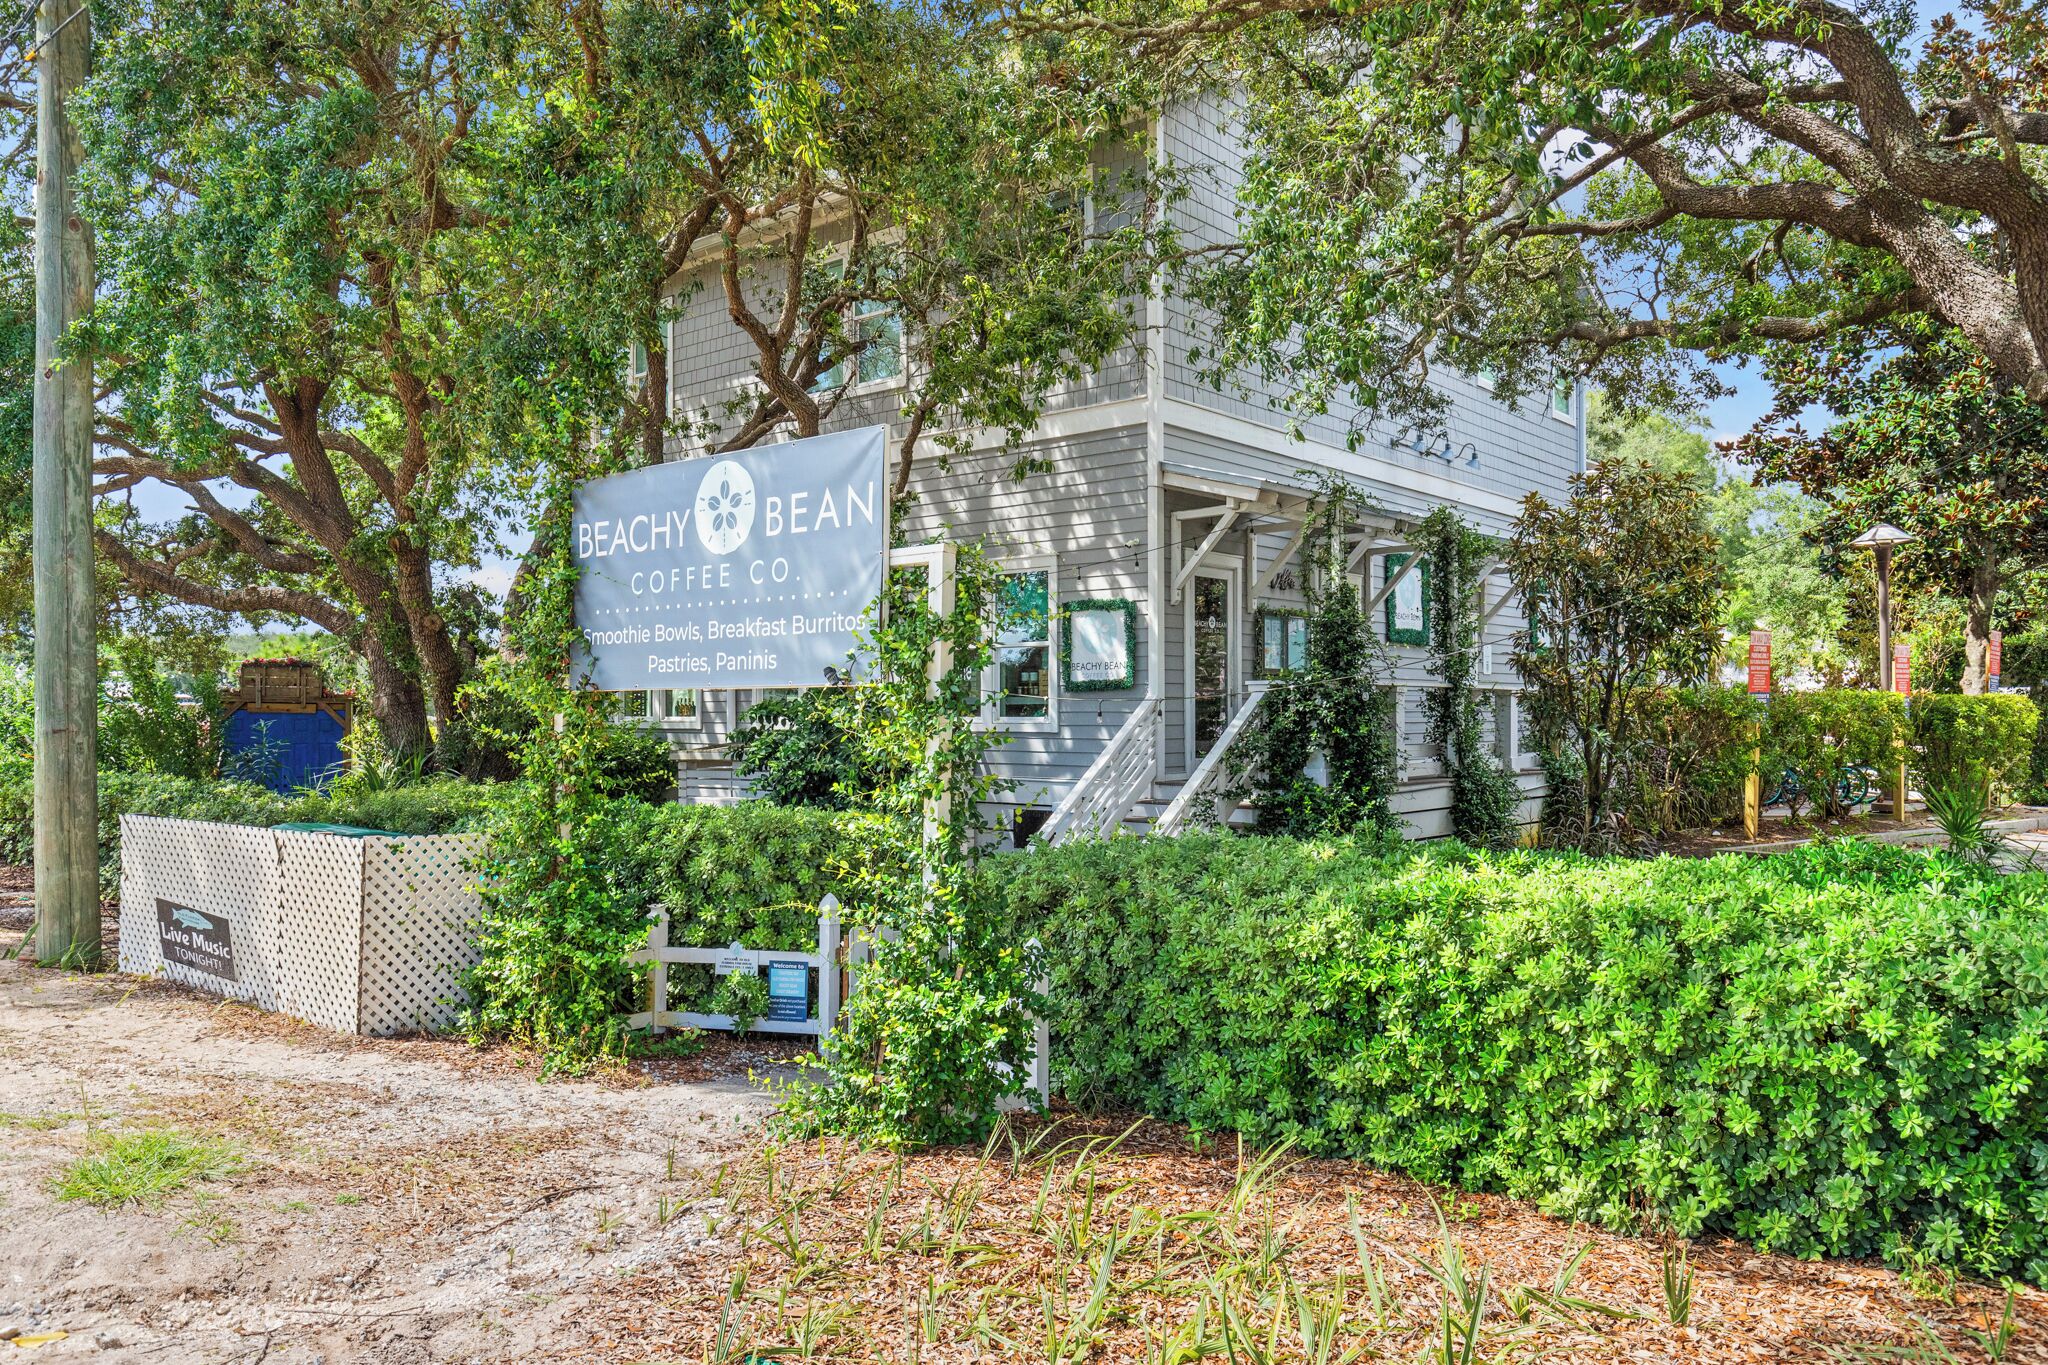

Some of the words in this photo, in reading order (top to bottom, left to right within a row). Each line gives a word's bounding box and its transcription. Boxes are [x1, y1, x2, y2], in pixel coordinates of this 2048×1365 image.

[578, 509, 690, 559] BEACHY
[765, 481, 875, 537] BEAN
[631, 563, 731, 596] COFFEE
[749, 557, 801, 585] CO.
[583, 624, 650, 646] Smoothie
[654, 621, 704, 643] Bowls,
[707, 615, 787, 640] Breakfast
[791, 611, 866, 635] Burritos
[647, 652, 711, 675] Pastries,
[715, 650, 778, 672] Paninis
[1071, 661, 1102, 671] BEACHY
[1104, 660, 1126, 670] BEAN
[160, 922, 190, 945] Live
[191, 931, 231, 959] Music
[174, 946, 223, 971] TONIGHT!
[773, 962, 797, 970] Welcome
